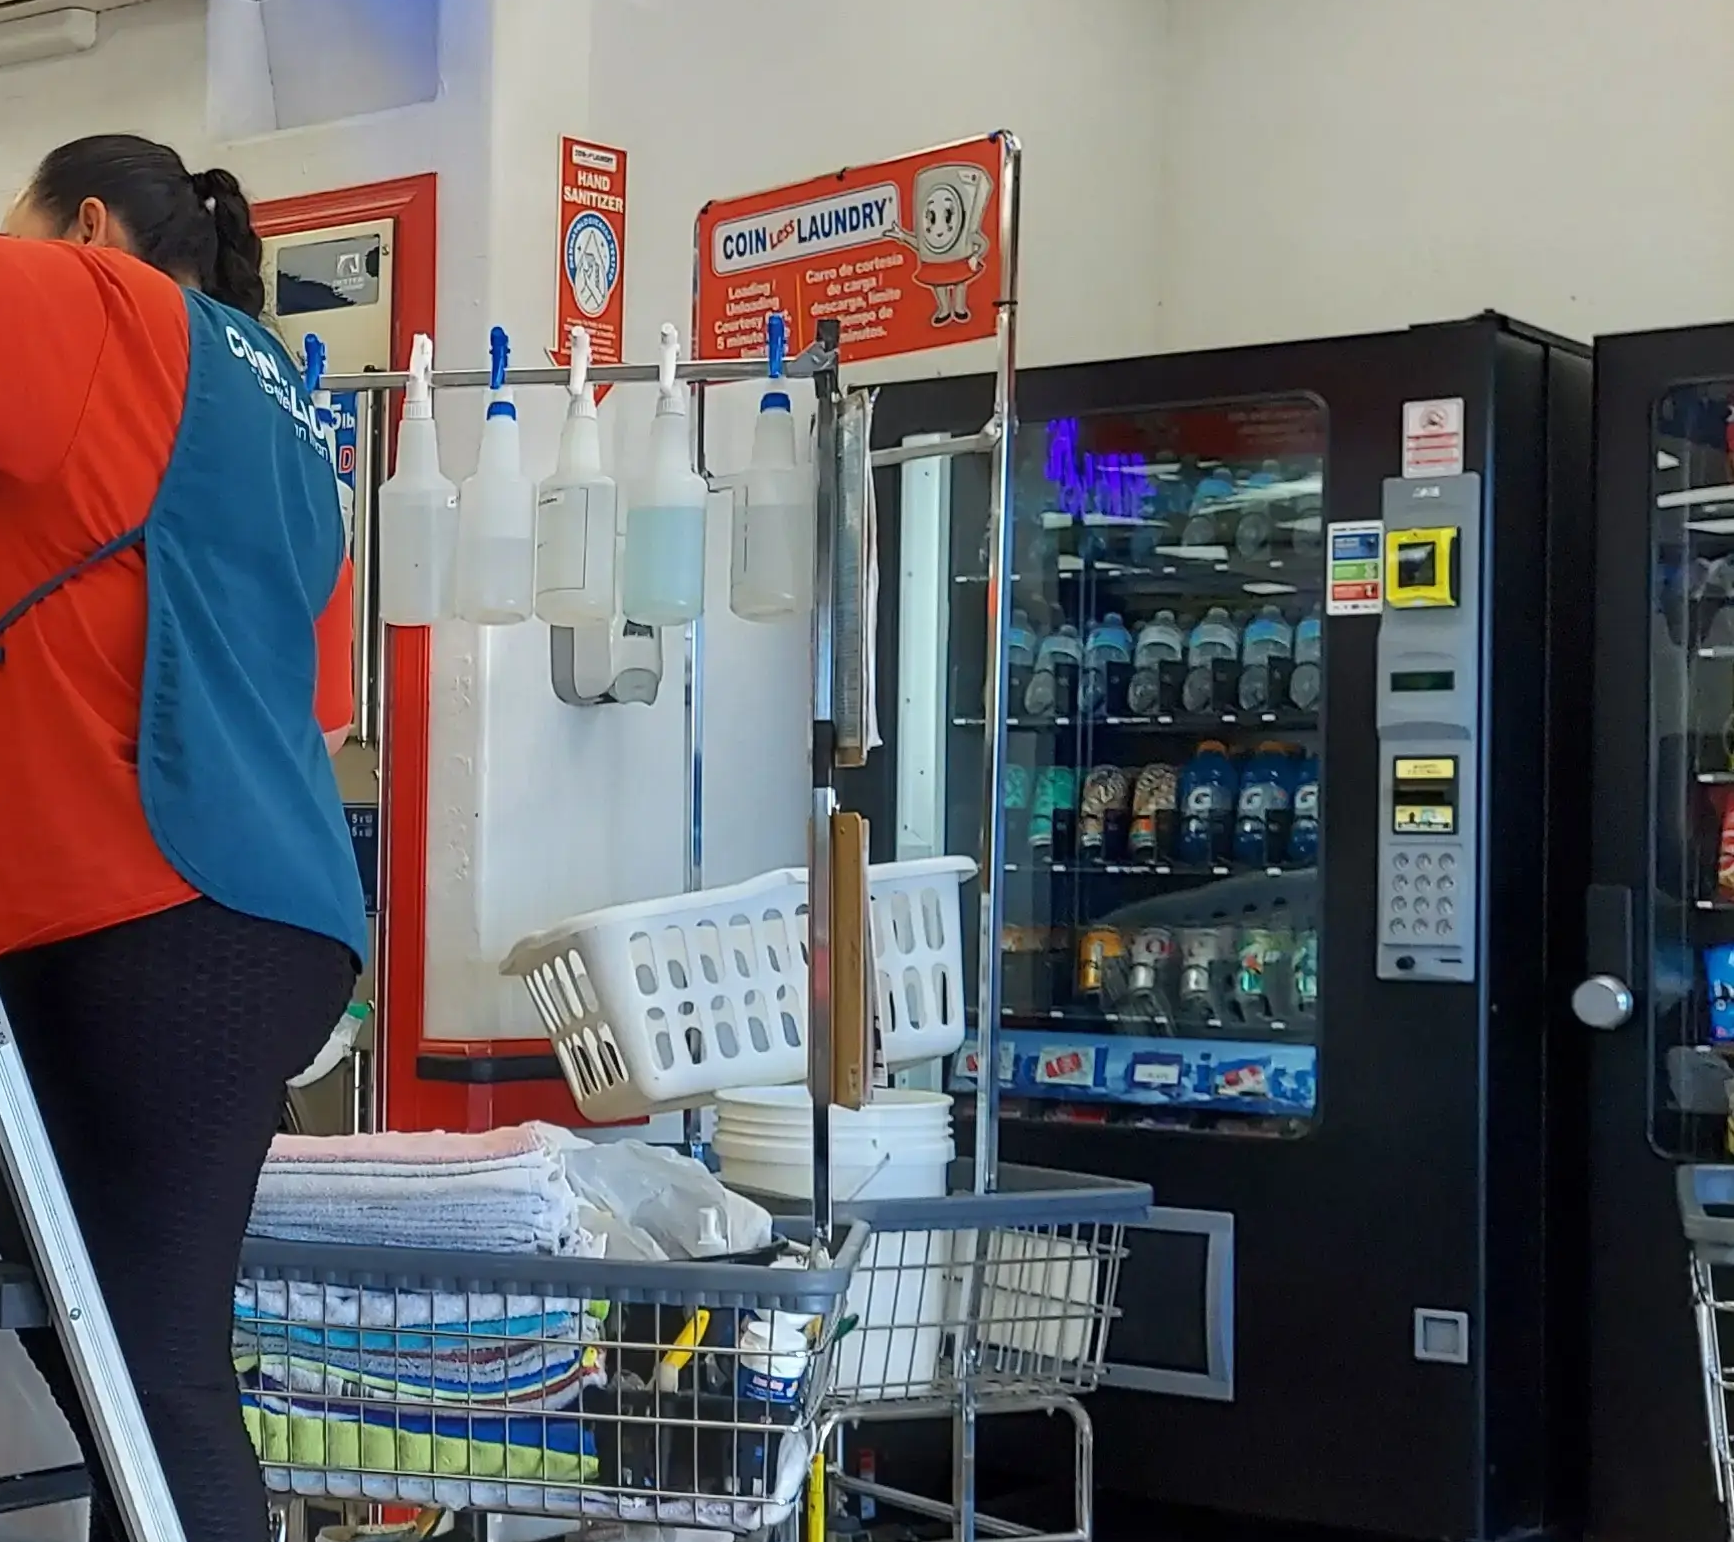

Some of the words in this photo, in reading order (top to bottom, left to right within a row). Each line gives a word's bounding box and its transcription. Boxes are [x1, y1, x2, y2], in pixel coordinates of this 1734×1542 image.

[577, 170, 611, 191] HAND
[563, 185, 624, 214] SANITIZER
[723, 227, 767, 260] COIN
[797, 198, 888, 244] LAUNDRY
[806, 268, 837, 284] Carro
[839, 263, 854, 277] de
[827, 281, 841, 296] de
[843, 276, 877, 292] carga
